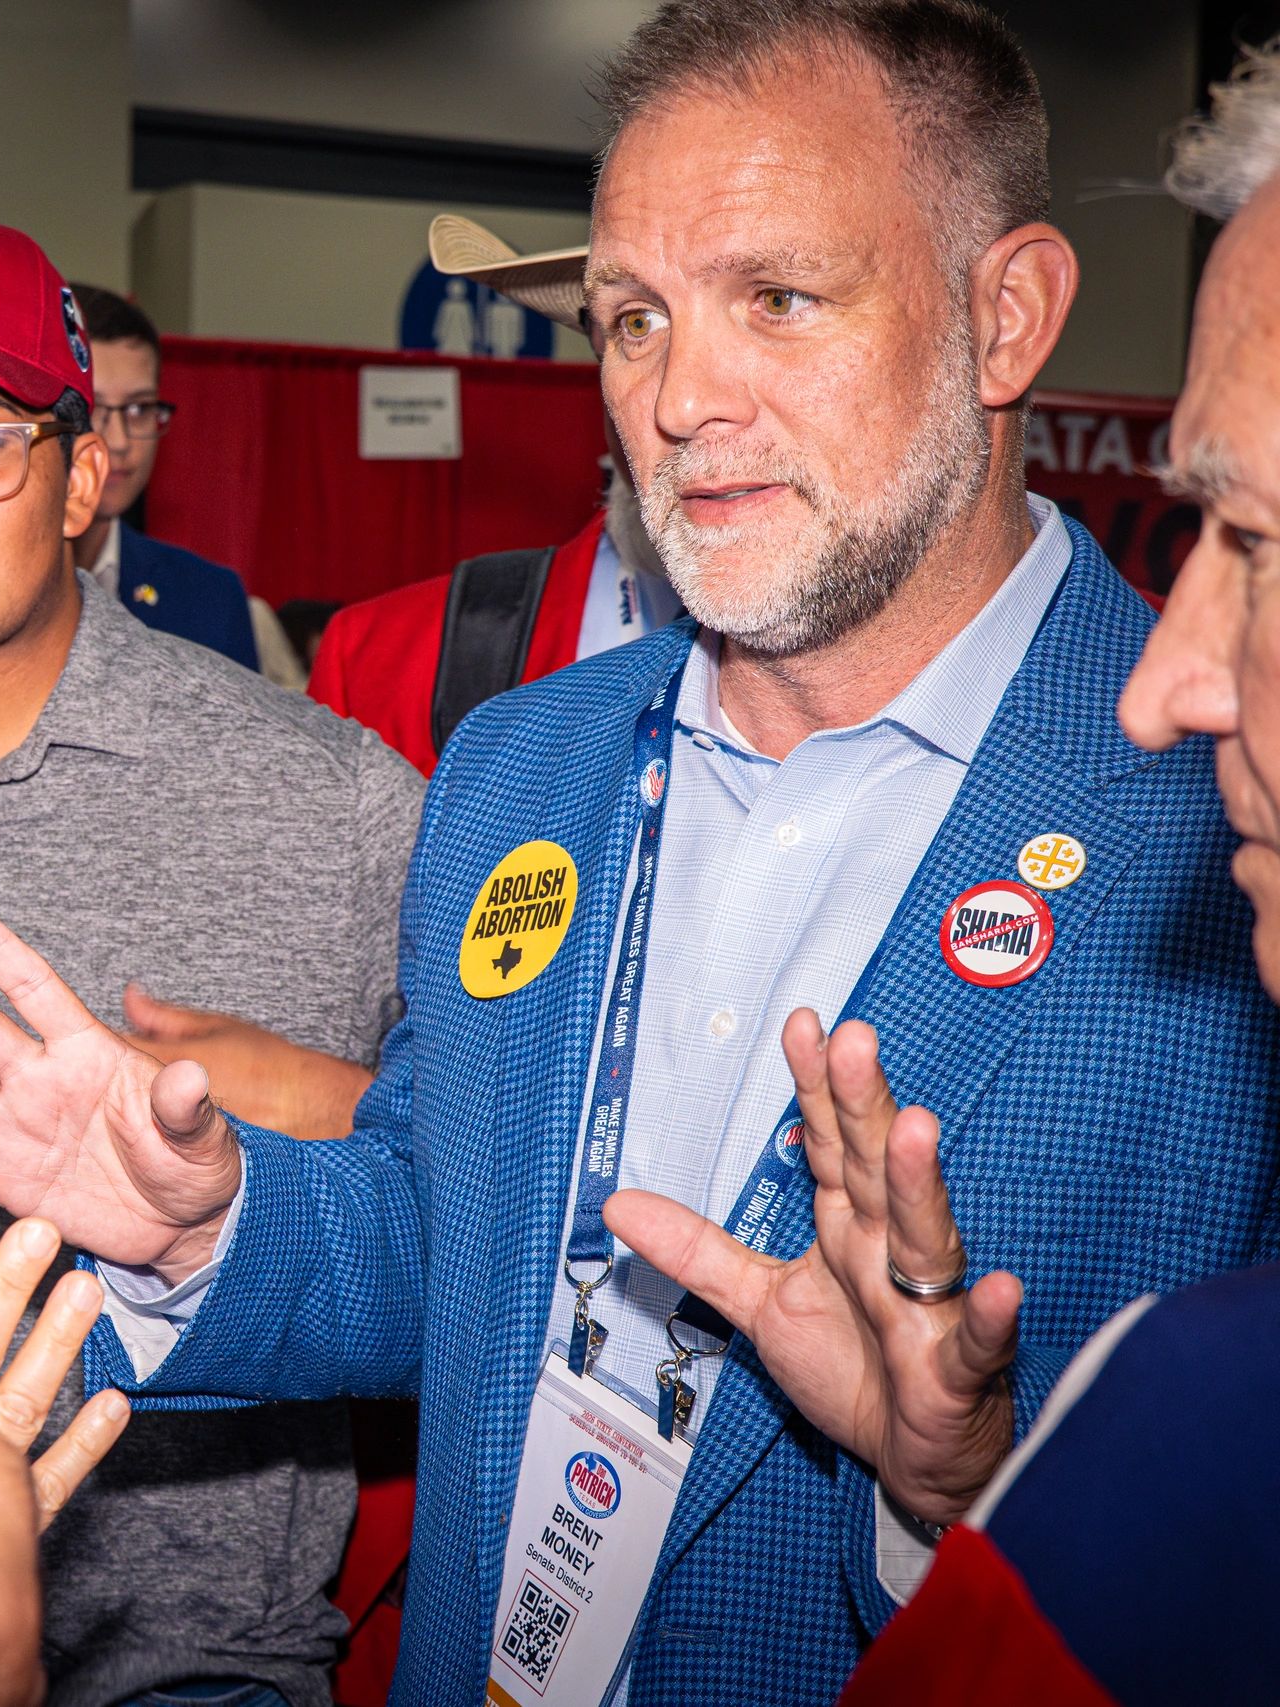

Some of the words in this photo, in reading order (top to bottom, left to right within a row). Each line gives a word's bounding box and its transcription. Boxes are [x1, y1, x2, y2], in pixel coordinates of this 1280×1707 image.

[1025, 412, 1135, 475] ATA
[486, 867, 567, 908] ABOLISH
[639, 856, 653, 894] MAKE
[471, 898, 567, 941] ABORTION
[628, 896, 647, 956] FAMILIES
[950, 914, 1039, 951] BANSHARIA.COM
[619, 960, 638, 1002] GREAT
[612, 1006, 628, 1048] AGAIN
[593, 1105, 610, 1138] GREAT
[608, 1098, 623, 1128] MAKE
[588, 1140, 604, 1173] AGAIN
[601, 1129, 618, 1178] FAMILIES
[741, 1178, 779, 1226] FAMILIES
[579, 1410, 596, 1423] 2026
[596, 1420, 614, 1437] STATE
[612, 1431, 645, 1458] CONVENTION
[564, 1476, 586, 1513] LIEUTENANT
[584, 1507, 614, 1519] GOVERNOR
[570, 1461, 616, 1509] PATRICK
[578, 1493, 597, 1509] TEXAS
[551, 1503, 604, 1551] BRENT
[540, 1525, 595, 1577] MONEY
[525, 1543, 556, 1574] Senate
[555, 1566, 586, 1599] District
[584, 1590, 594, 1604] 2
